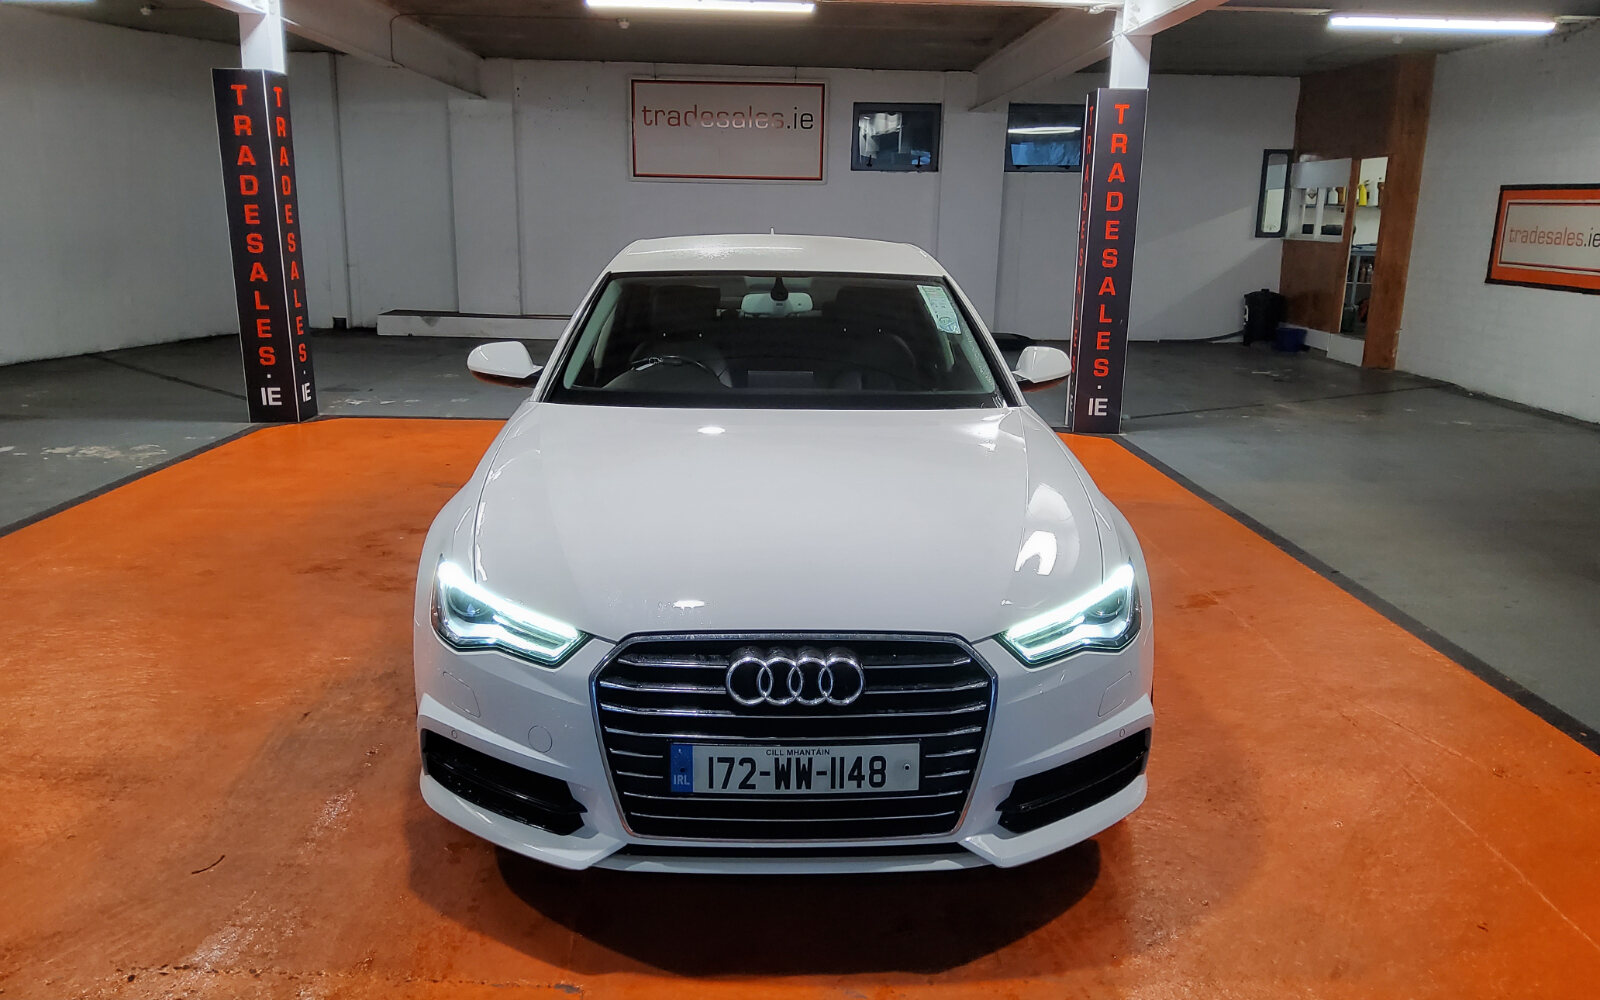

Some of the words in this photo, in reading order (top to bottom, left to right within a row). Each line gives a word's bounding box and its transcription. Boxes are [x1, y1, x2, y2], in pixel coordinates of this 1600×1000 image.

[641, 104, 814, 130] tradesales.ie
[1508, 225, 1600, 248] tradesales.ie
[786, 748, 830, 756] MHANTÁIN
[673, 774, 690, 786] IRL
[708, 755, 887, 790] 172-WW-1148
